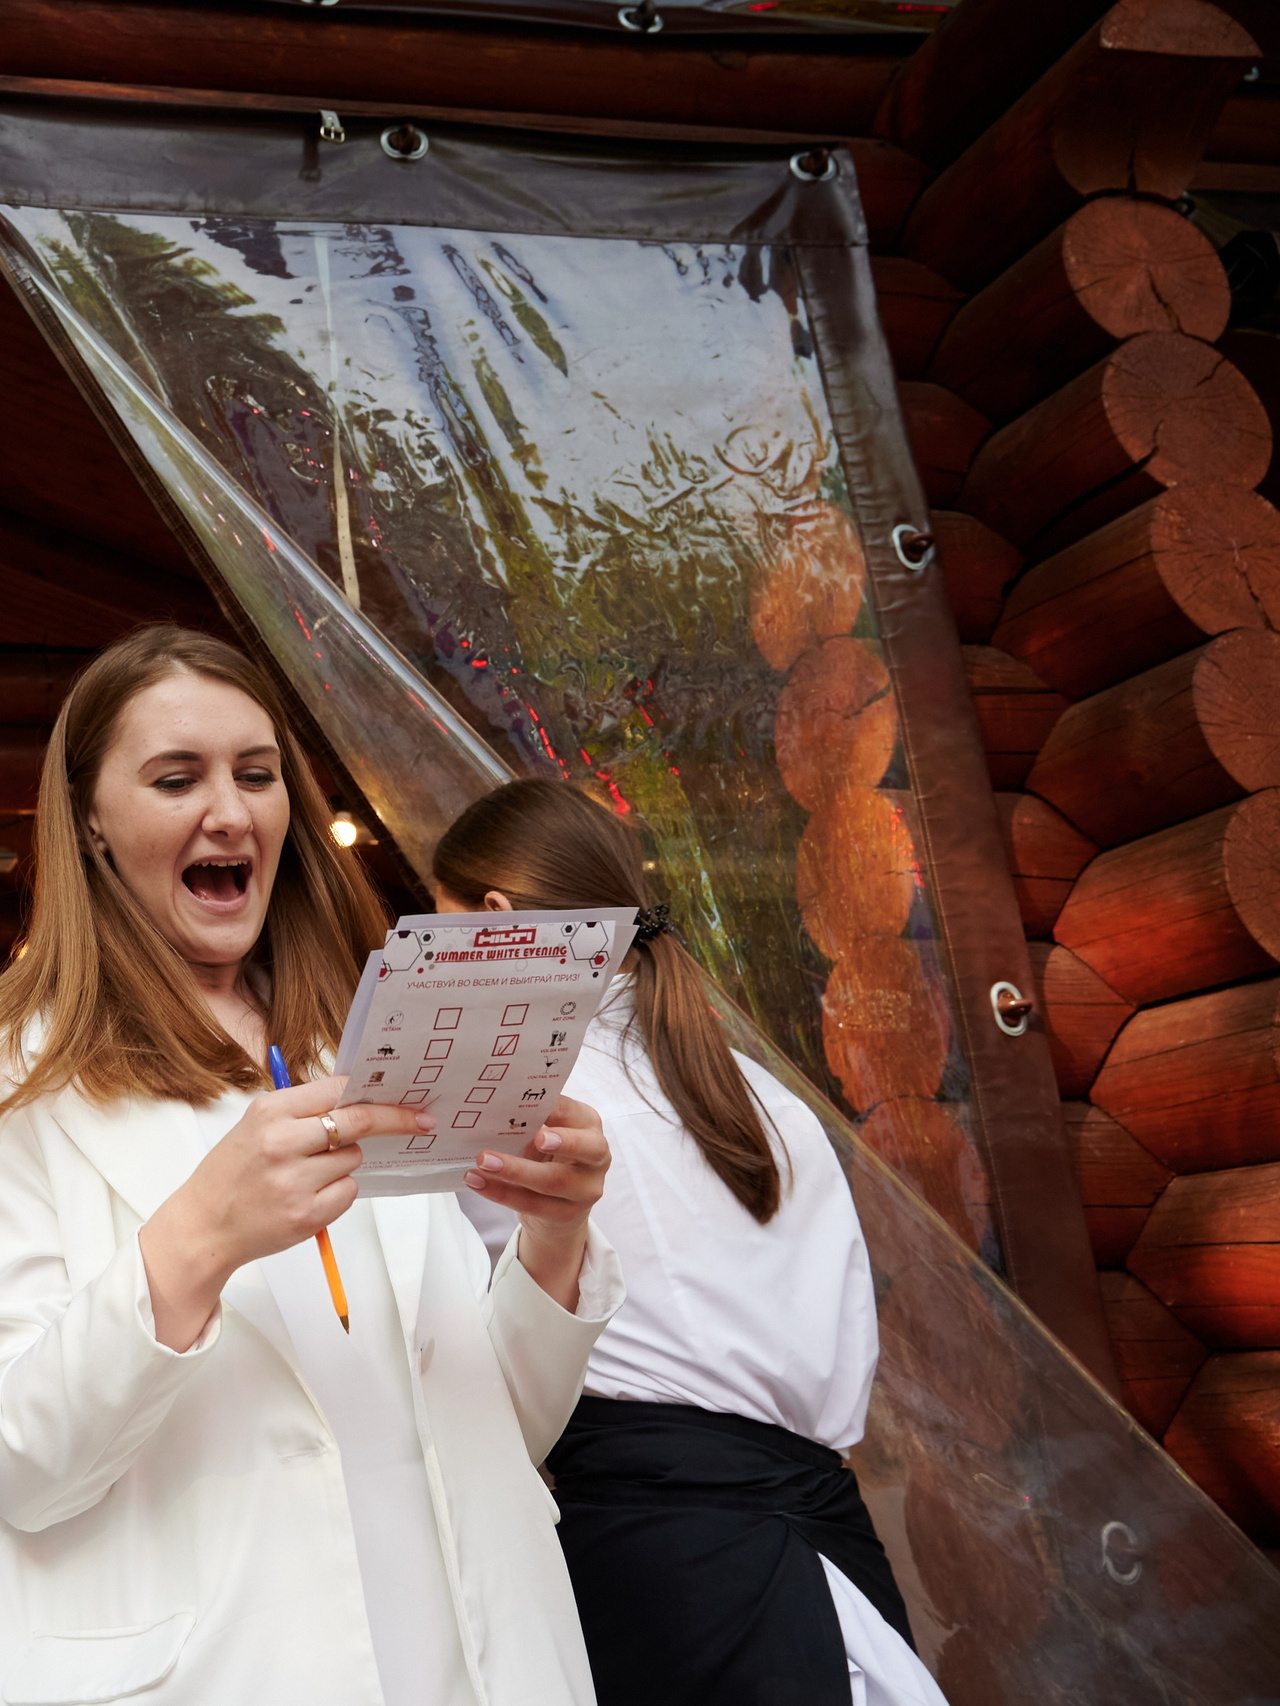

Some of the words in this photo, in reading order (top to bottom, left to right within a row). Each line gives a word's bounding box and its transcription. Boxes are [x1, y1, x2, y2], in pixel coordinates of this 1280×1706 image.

[476, 932, 533, 945] HILTI
[435, 951, 483, 961] SUMMER
[486, 948, 520, 959] WHITE
[523, 946, 568, 957] EVENING
[406, 978, 456, 989] УЧАСТВУЙ
[457, 979, 471, 988] ВО
[472, 978, 500, 987] ВСЕМ
[500, 977, 508, 985] И
[509, 974, 552, 985] ВЫИГРАЙ
[553, 973, 580, 982] ПРИЗ!
